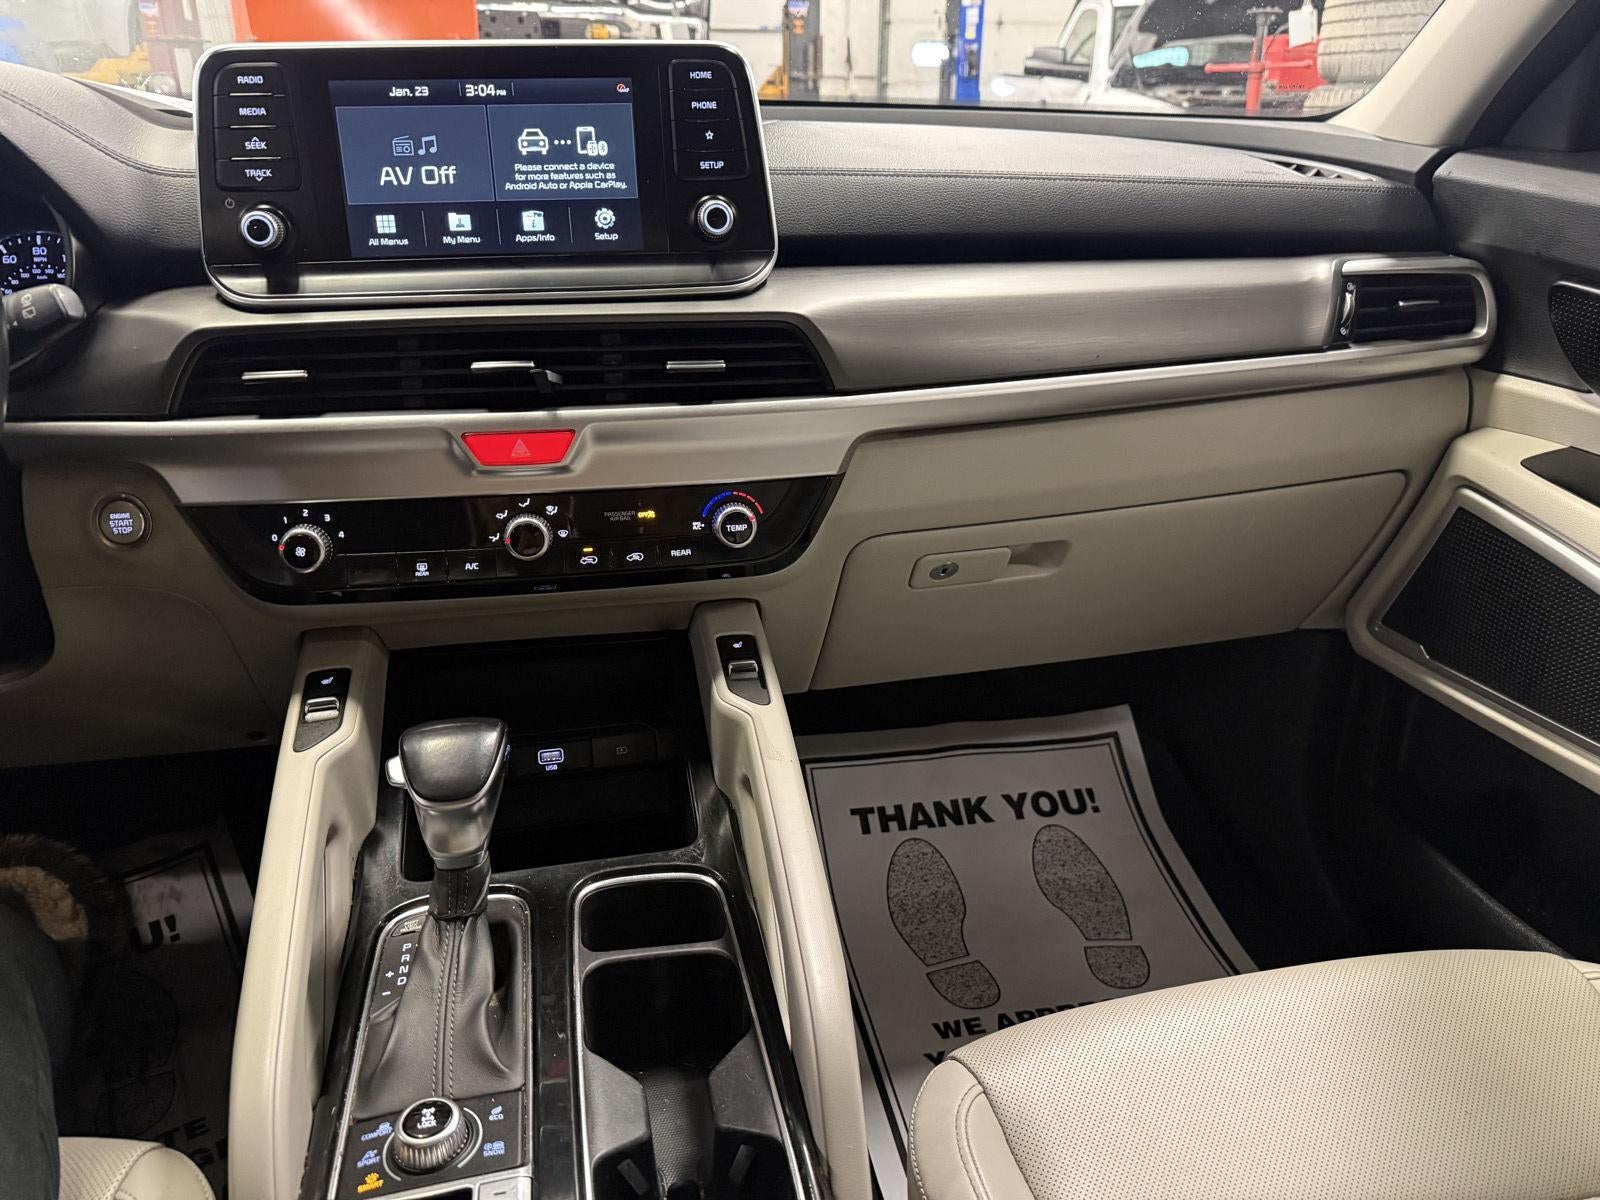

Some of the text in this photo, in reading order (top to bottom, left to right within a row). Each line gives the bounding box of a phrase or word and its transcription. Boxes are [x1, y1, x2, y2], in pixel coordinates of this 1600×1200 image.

[690, 71, 712, 79] HOME
[237, 76, 263, 84] RADIO
[415, 86, 429, 97] 23
[465, 84, 495, 97] 3:04
[691, 101, 717, 109] PHONE
[239, 108, 266, 116] MEDIA
[245, 140, 267, 150] SEEK
[514, 163, 542, 172] Please
[543, 162, 578, 171] connect
[587, 162, 615, 170] device
[700, 161, 724, 170] SETUP
[245, 169, 272, 178] TRACK
[380, 165, 457, 186] AV Off
[515, 172, 526, 181] for
[550, 171, 584, 180] features
[585, 171, 605, 179] such
[505, 182, 537, 191] Android
[538, 182, 558, 190] Auto
[569, 181, 594, 190] Apple
[595, 180, 628, 190] CarPlay.
[443, 235, 481, 245] My Menu
[516, 233, 555, 243] Apps/Info
[595, 232, 619, 241] Setup
[368, 238, 408, 246] All Menus
[32, 247, 48, 256] 80
[2, 255, 18, 264] 60
[302, 508, 309, 517] 2
[283, 516, 288, 525] 1
[324, 514, 331, 522] 3
[109, 519, 133, 528] START
[726, 523, 748, 532] TEMP
[112, 526, 133, 535] STOP
[338, 530, 345, 539] 4
[271, 533, 278, 542] 0
[670, 548, 692, 557] REAR
[465, 562, 479, 571] A/C
[849, 787, 1101, 835] THANK YOU!
[402, 942, 412, 952] P
[399, 964, 409, 974] N
[397, 976, 407, 986] D
[932, 1016, 986, 1040] WE
[417, 1120, 437, 1130] LOCK
[357, 1155, 380, 1168] SPORT
